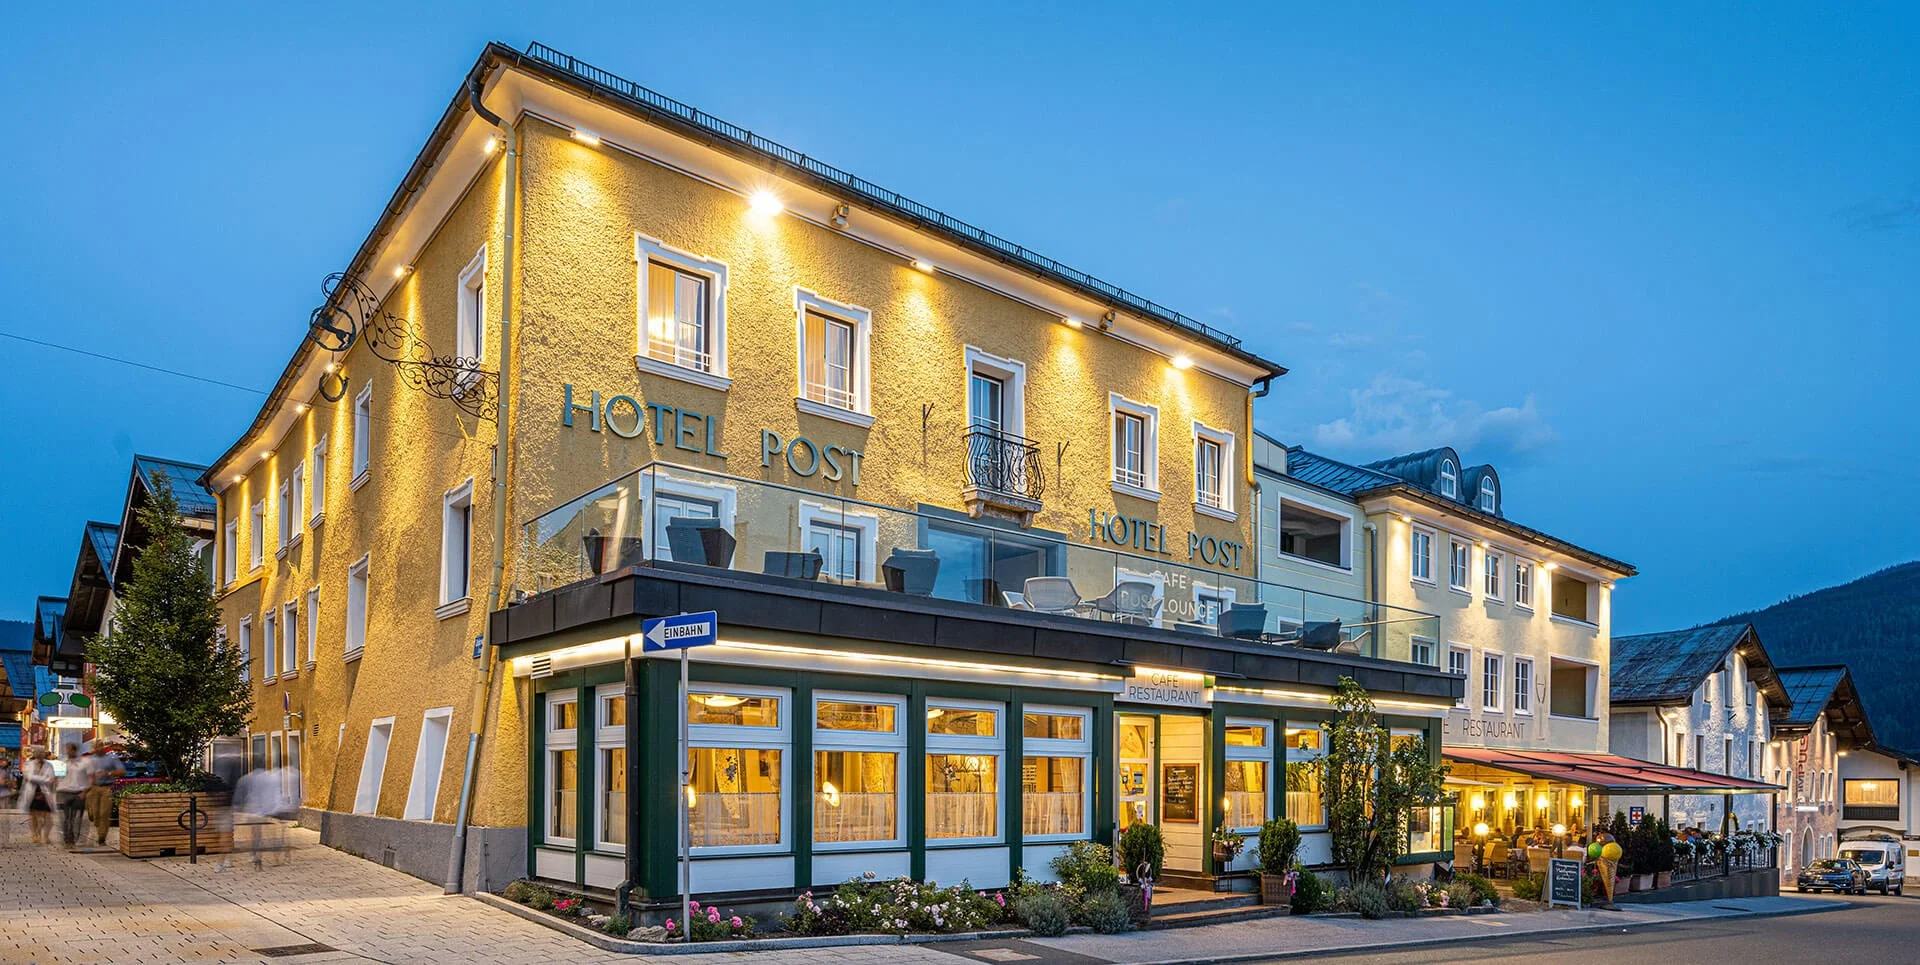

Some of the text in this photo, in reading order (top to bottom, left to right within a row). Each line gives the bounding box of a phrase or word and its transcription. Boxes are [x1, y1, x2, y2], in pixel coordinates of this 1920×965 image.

[563, 383, 864, 486] HOTEL POST
[1089, 508, 1243, 570] HOTEL POST
[664, 624, 703, 639] EINBAHN
[1151, 673, 1178, 688] CAFE
[1129, 686, 1199, 704] RESTAURANT
[1463, 718, 1525, 739] RESTAURANT
